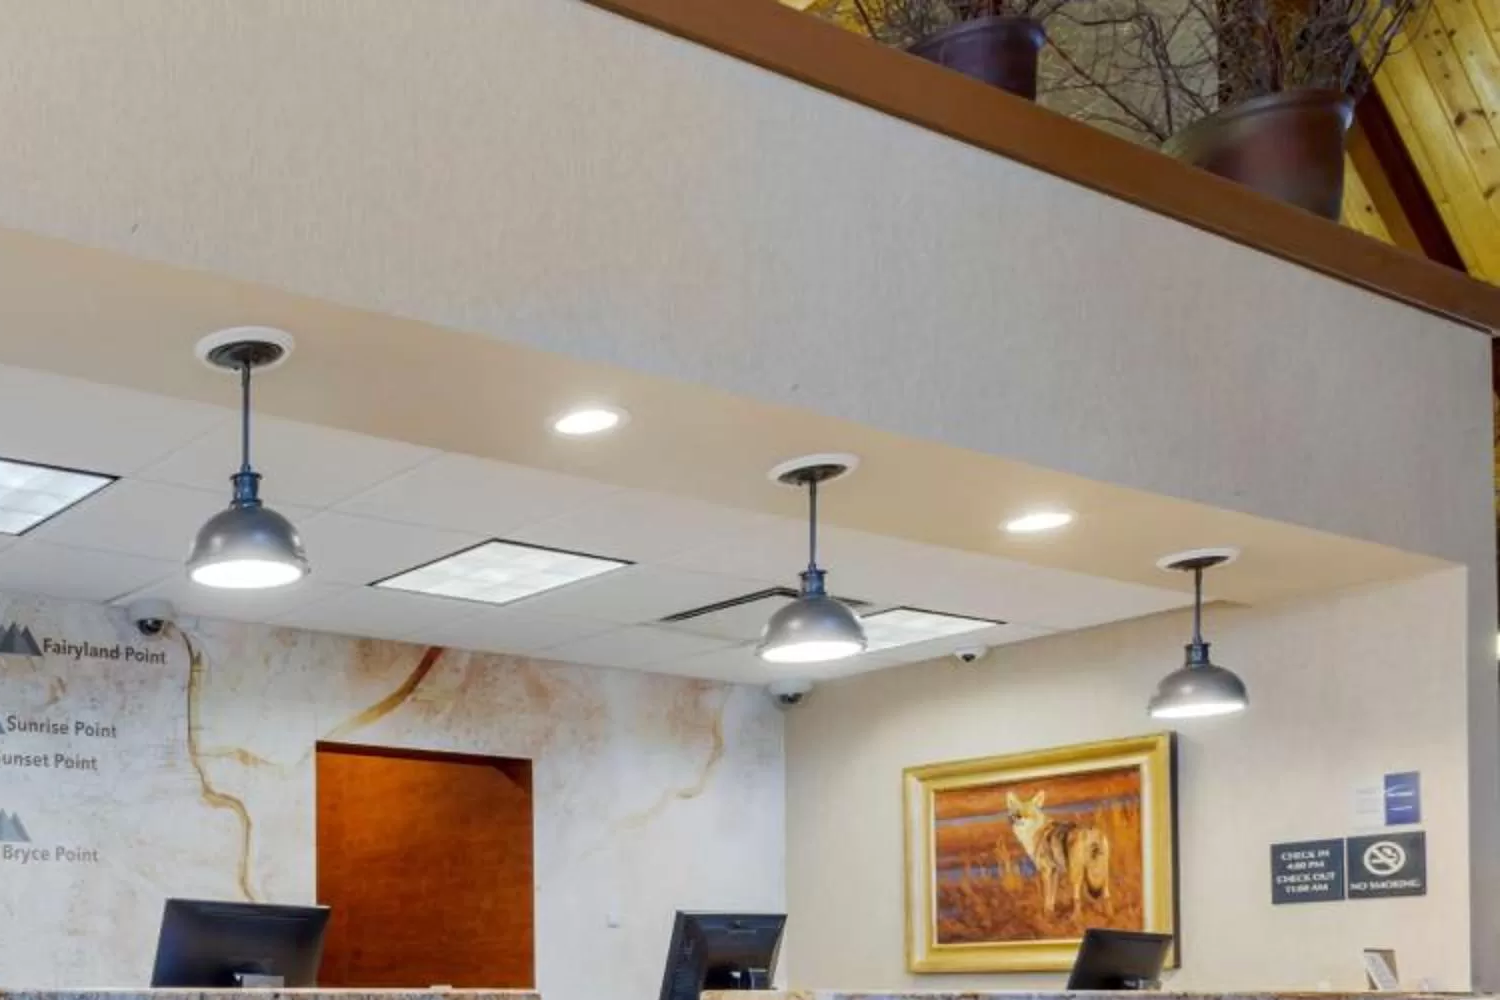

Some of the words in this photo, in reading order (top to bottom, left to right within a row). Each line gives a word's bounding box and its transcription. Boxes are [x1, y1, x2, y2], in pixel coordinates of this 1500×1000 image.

[43, 638, 121, 661] Fairyland
[125, 642, 167, 664] Point
[7, 716, 69, 735] Sunrise
[75, 721, 117, 738] Point
[56, 754, 98, 770] Point
[3, 844, 50, 865] Bryce
[56, 846, 99, 863] Point
[1350, 882, 1367, 891] NO
